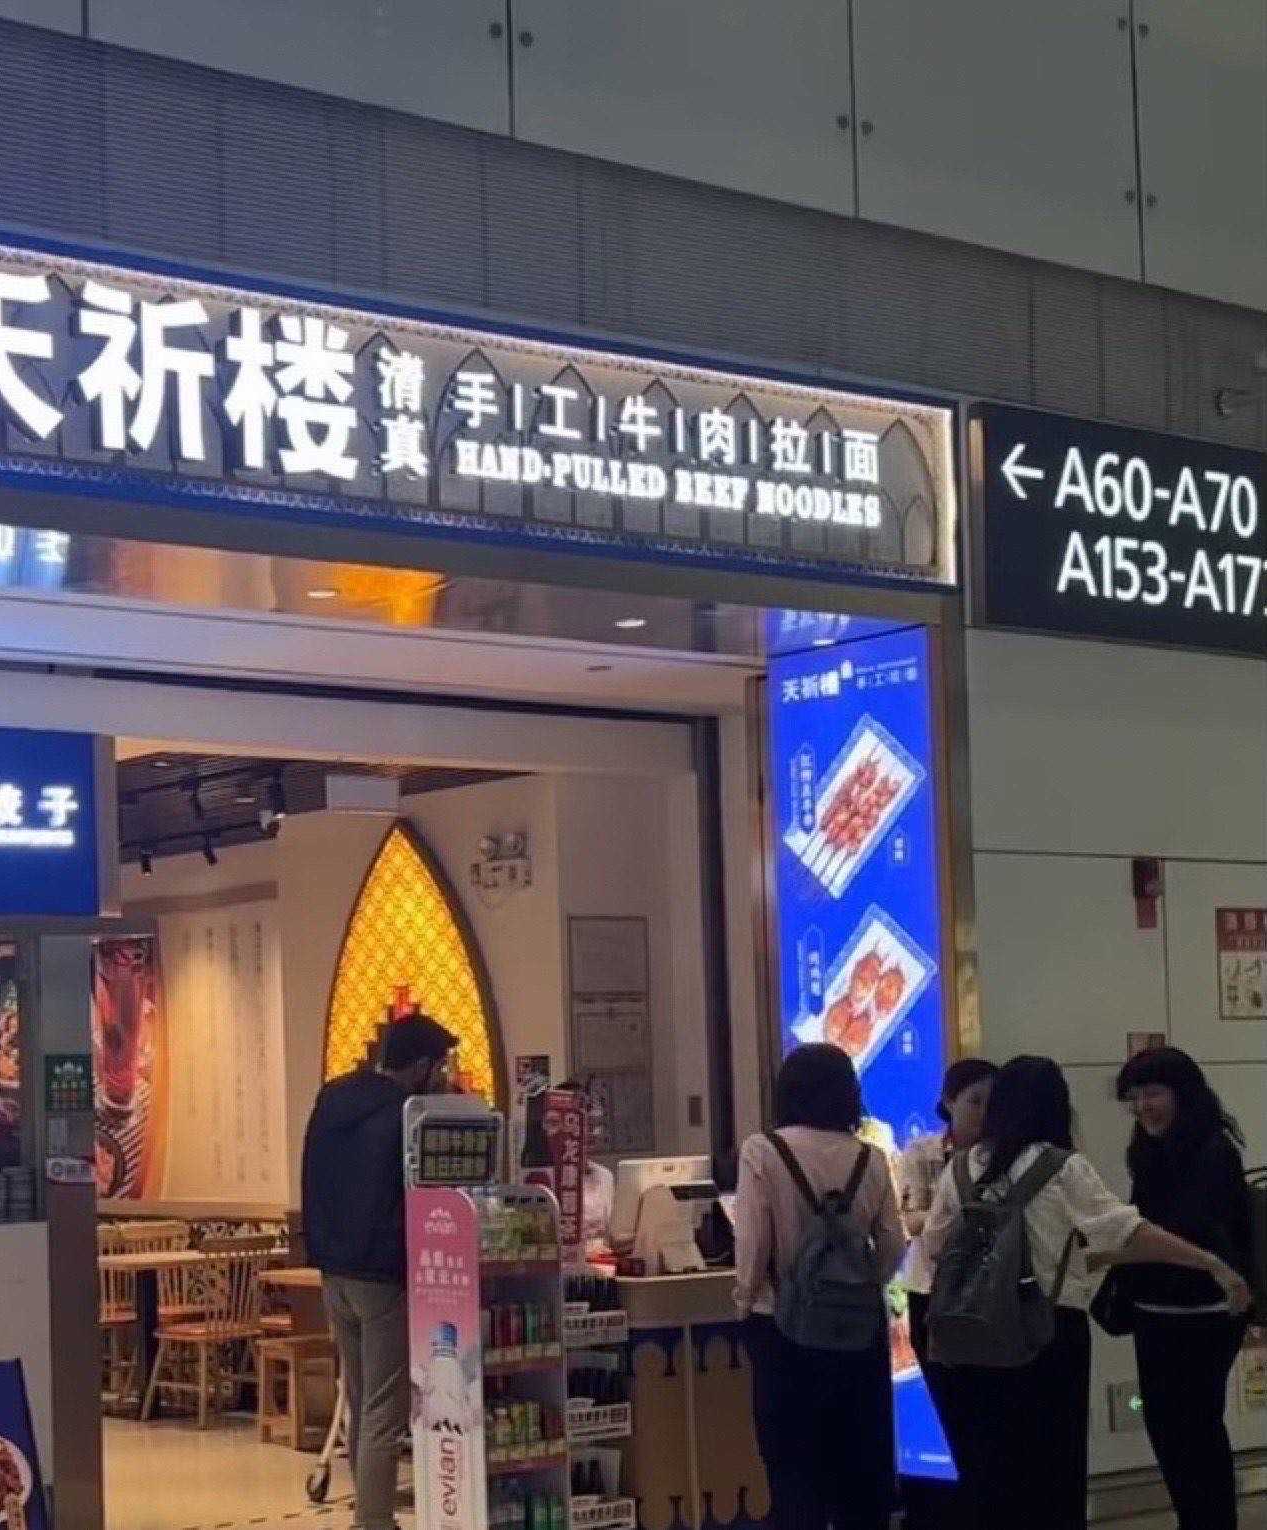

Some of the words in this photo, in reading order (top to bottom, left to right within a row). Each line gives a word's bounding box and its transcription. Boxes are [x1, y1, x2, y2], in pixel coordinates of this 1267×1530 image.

[378, 346, 429, 479] 清真
[454, 439, 667, 500] HAND-PULLED
[756, 480, 881, 528] NOODLES
[1053, 446, 1258, 539] A60-A70
[1056, 530, 1267, 616] A153-A17
[439, 1437, 458, 1517] evian
